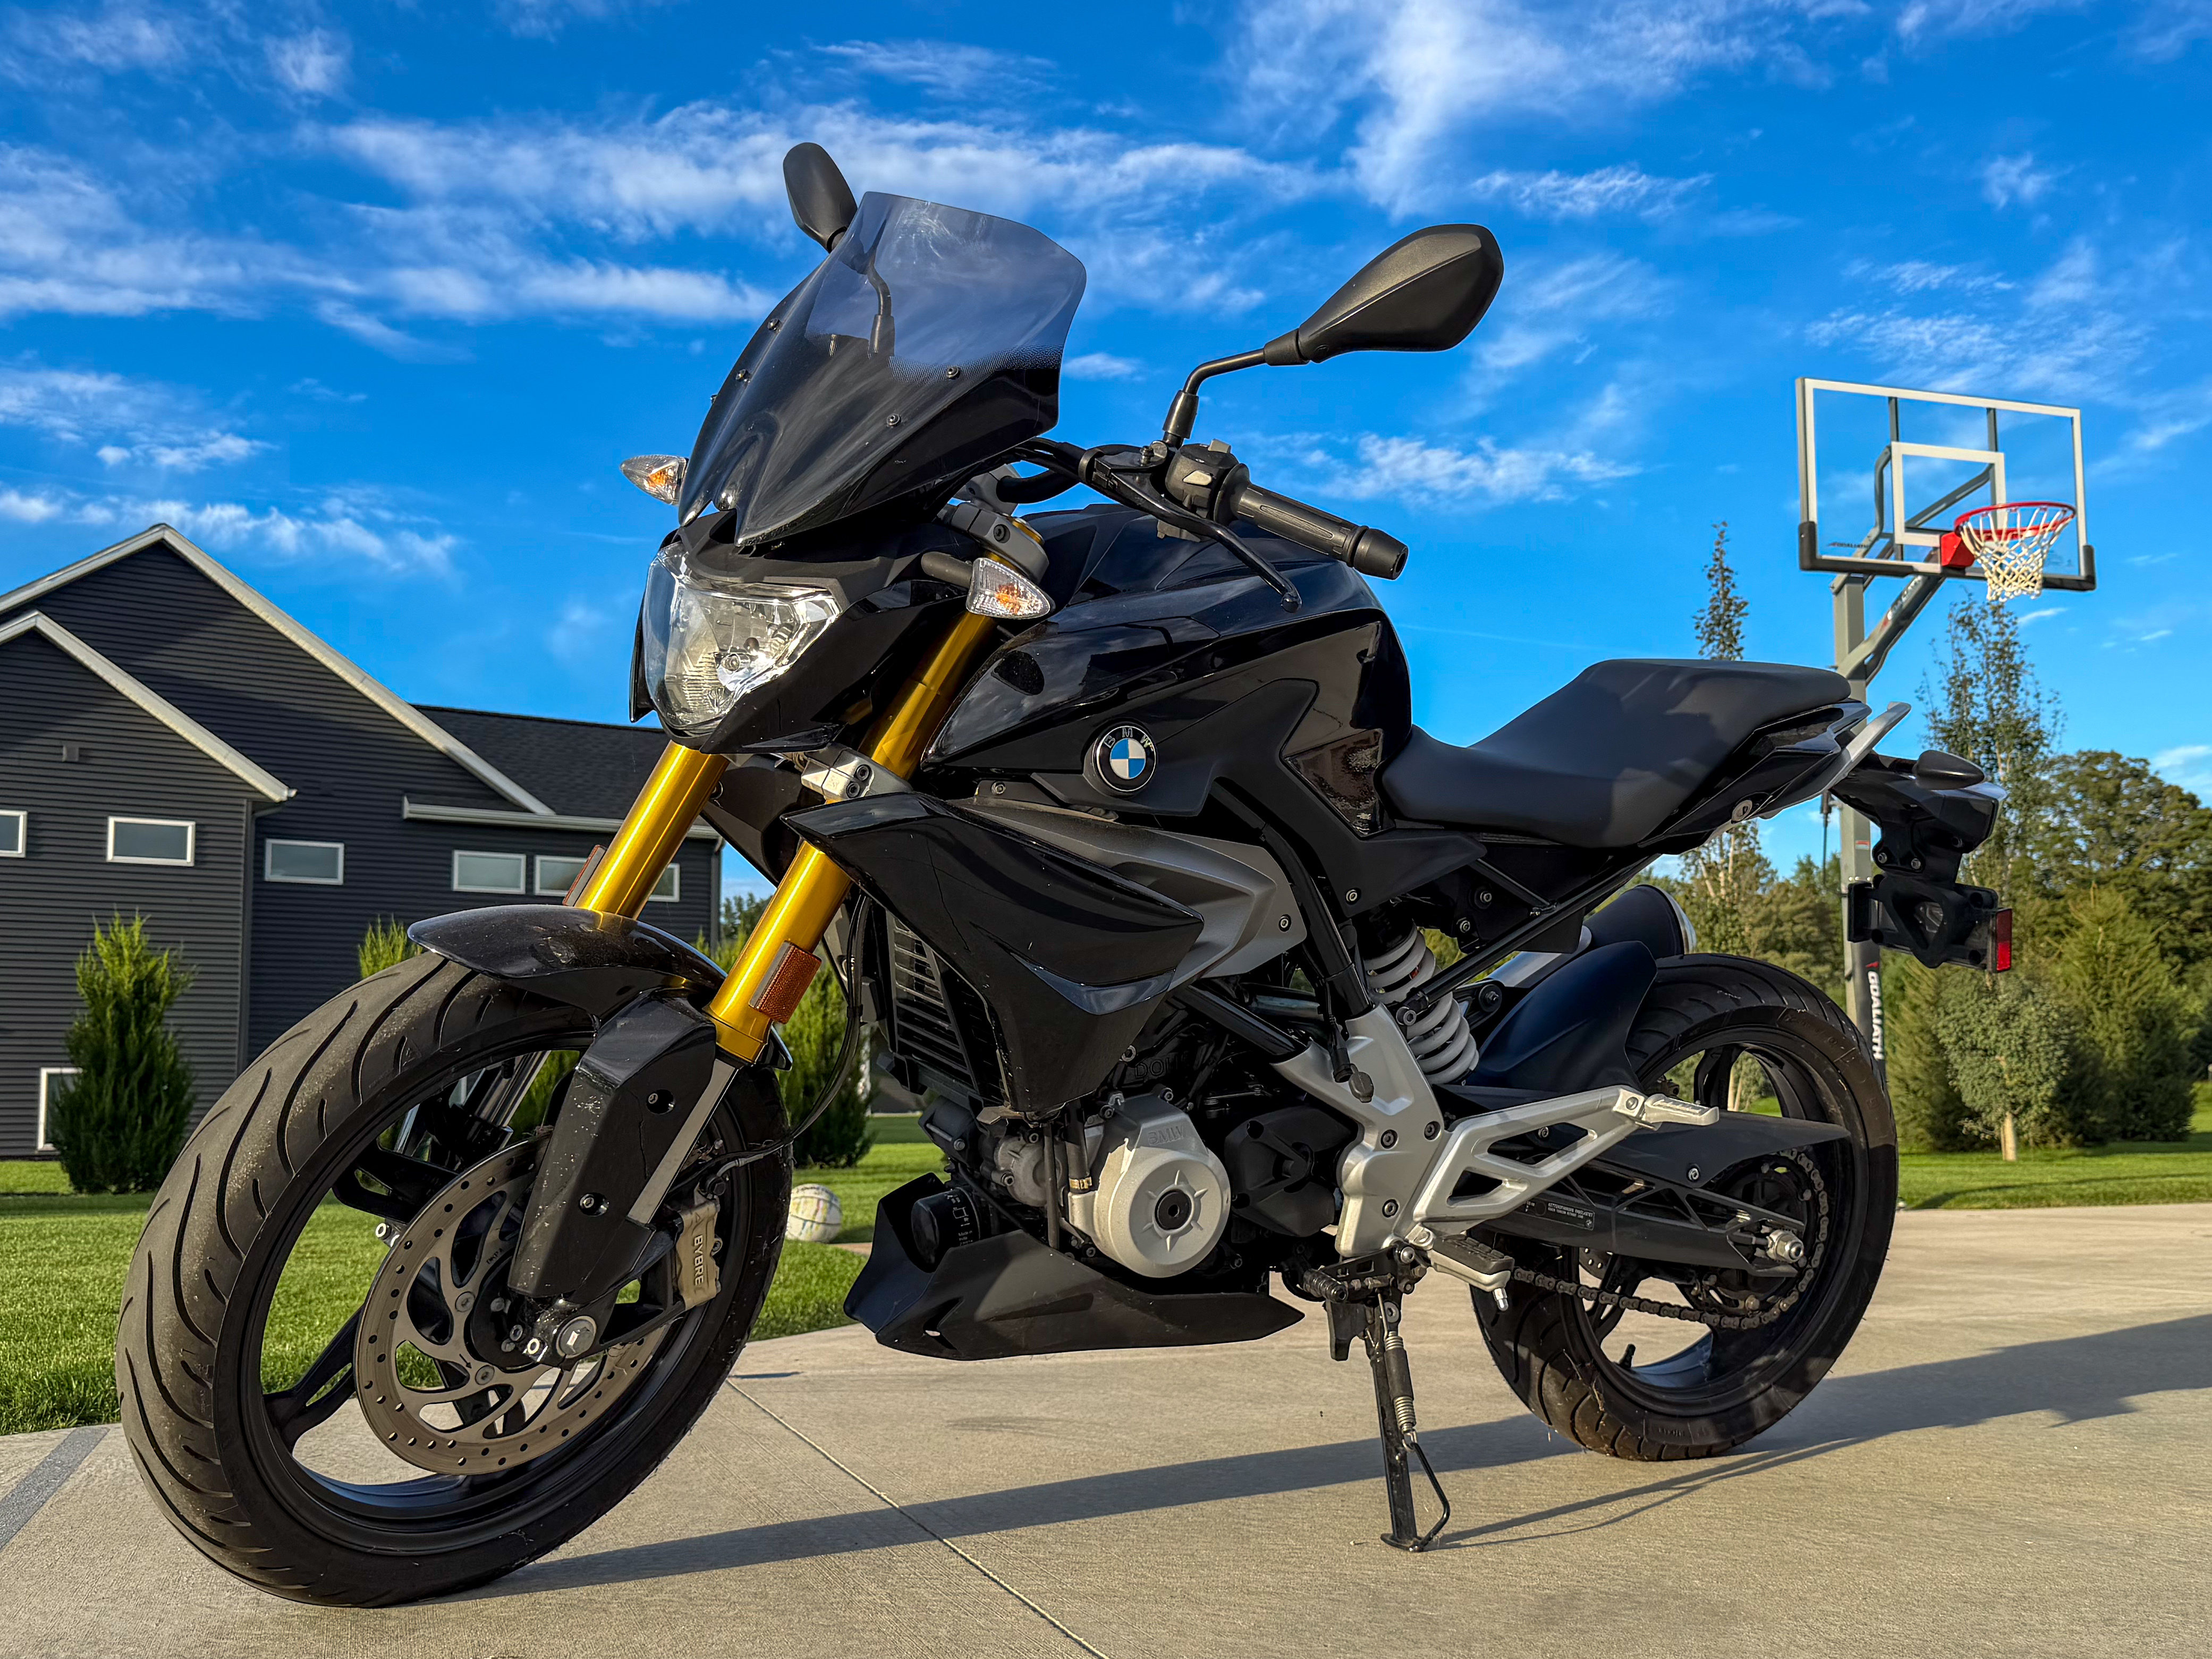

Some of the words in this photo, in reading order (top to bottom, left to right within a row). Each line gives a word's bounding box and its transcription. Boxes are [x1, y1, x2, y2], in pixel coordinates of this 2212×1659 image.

[1104, 727, 1154, 751] BMW
[1868, 970, 1885, 1061] GOALIATH
[1148, 1125, 1184, 1146] BMW
[693, 1234, 704, 1286] BYBRE
